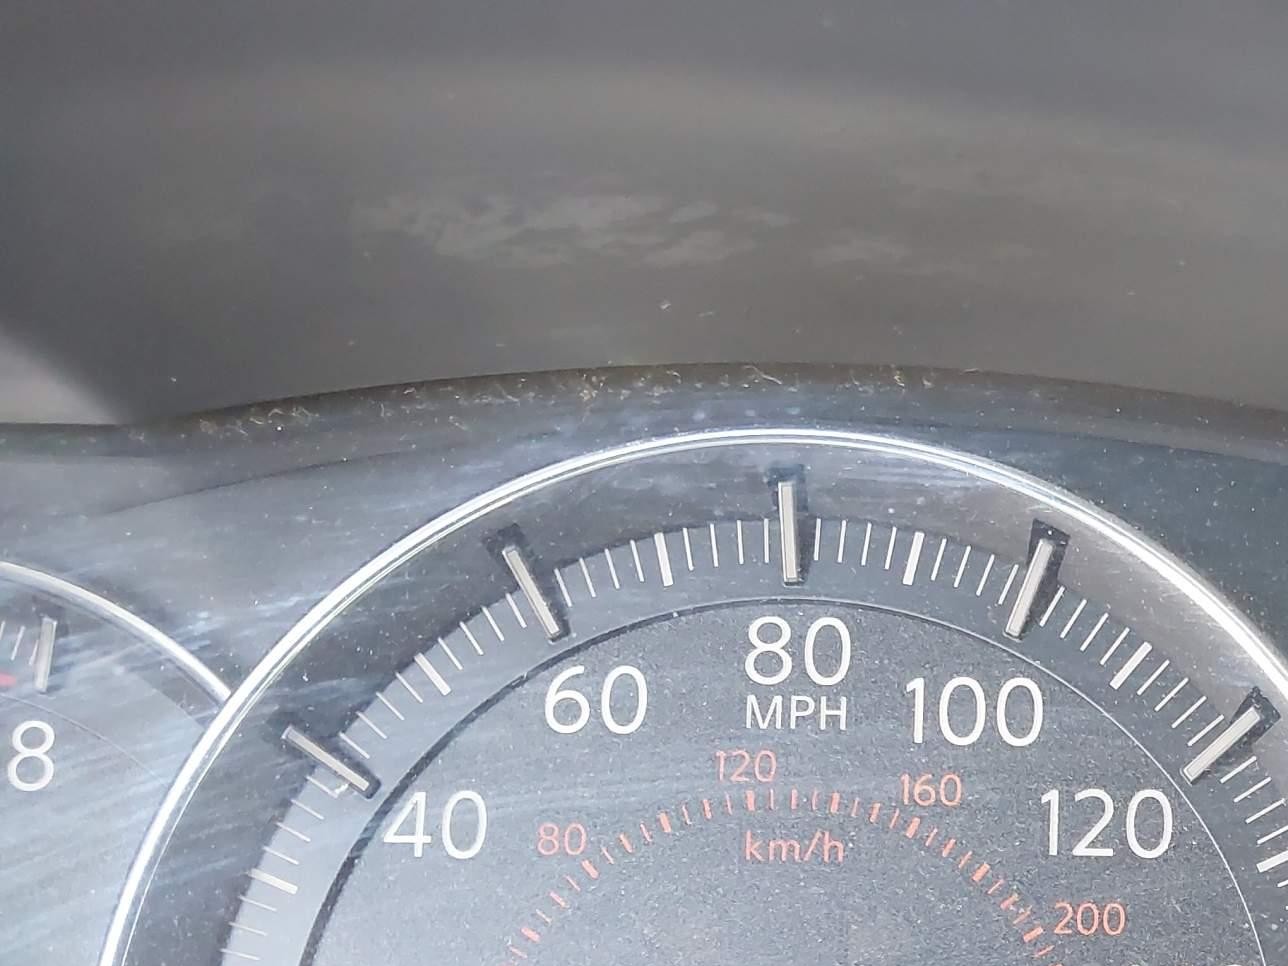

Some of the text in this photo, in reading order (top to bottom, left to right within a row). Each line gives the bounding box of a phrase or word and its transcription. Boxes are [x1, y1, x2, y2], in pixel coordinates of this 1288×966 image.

[743, 616, 852, 687] 80
[543, 665, 649, 735] 60
[744, 695, 848, 731] MPH
[905, 676, 1044, 747] 100
[7, 720, 56, 792] 8
[715, 750, 777, 784] 120
[899, 773, 963, 807] 160
[383, 790, 489, 860] 40
[536, 823, 587, 856] 80
[743, 832, 845, 863] km/h
[1040, 788, 1175, 859] 120
[1053, 902, 1126, 937] 200
